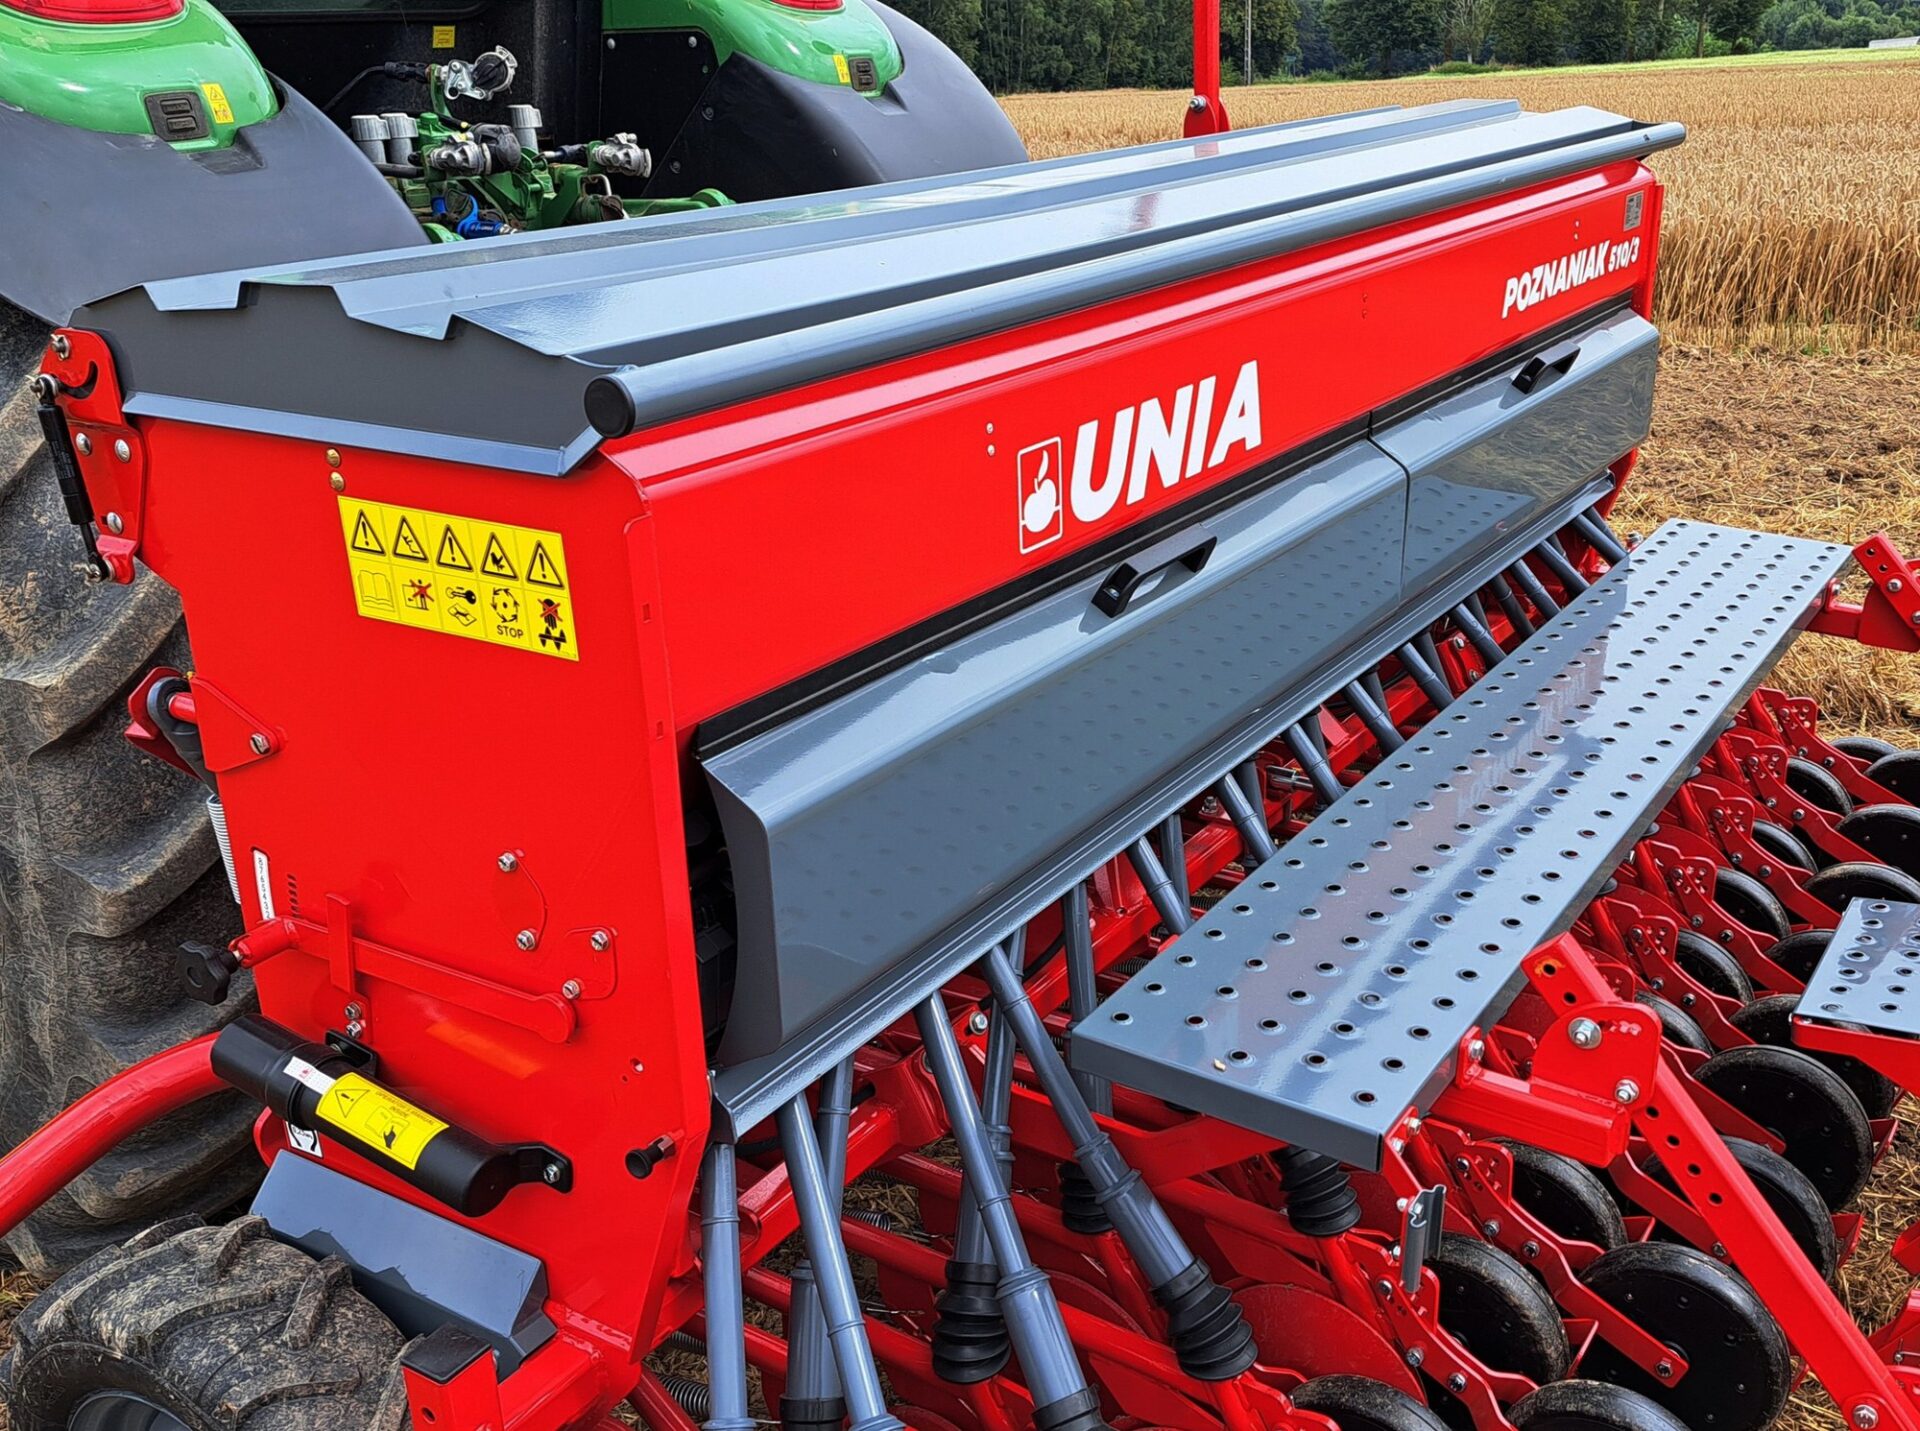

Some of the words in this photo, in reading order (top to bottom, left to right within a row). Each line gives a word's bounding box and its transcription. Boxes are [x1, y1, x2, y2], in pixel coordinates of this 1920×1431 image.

[1502, 240, 1610, 319] POZNANIAK
[1608, 236, 1641, 272] 510/3
[1070, 360, 1262, 522] UNIA
[496, 624, 524, 639] STOP
